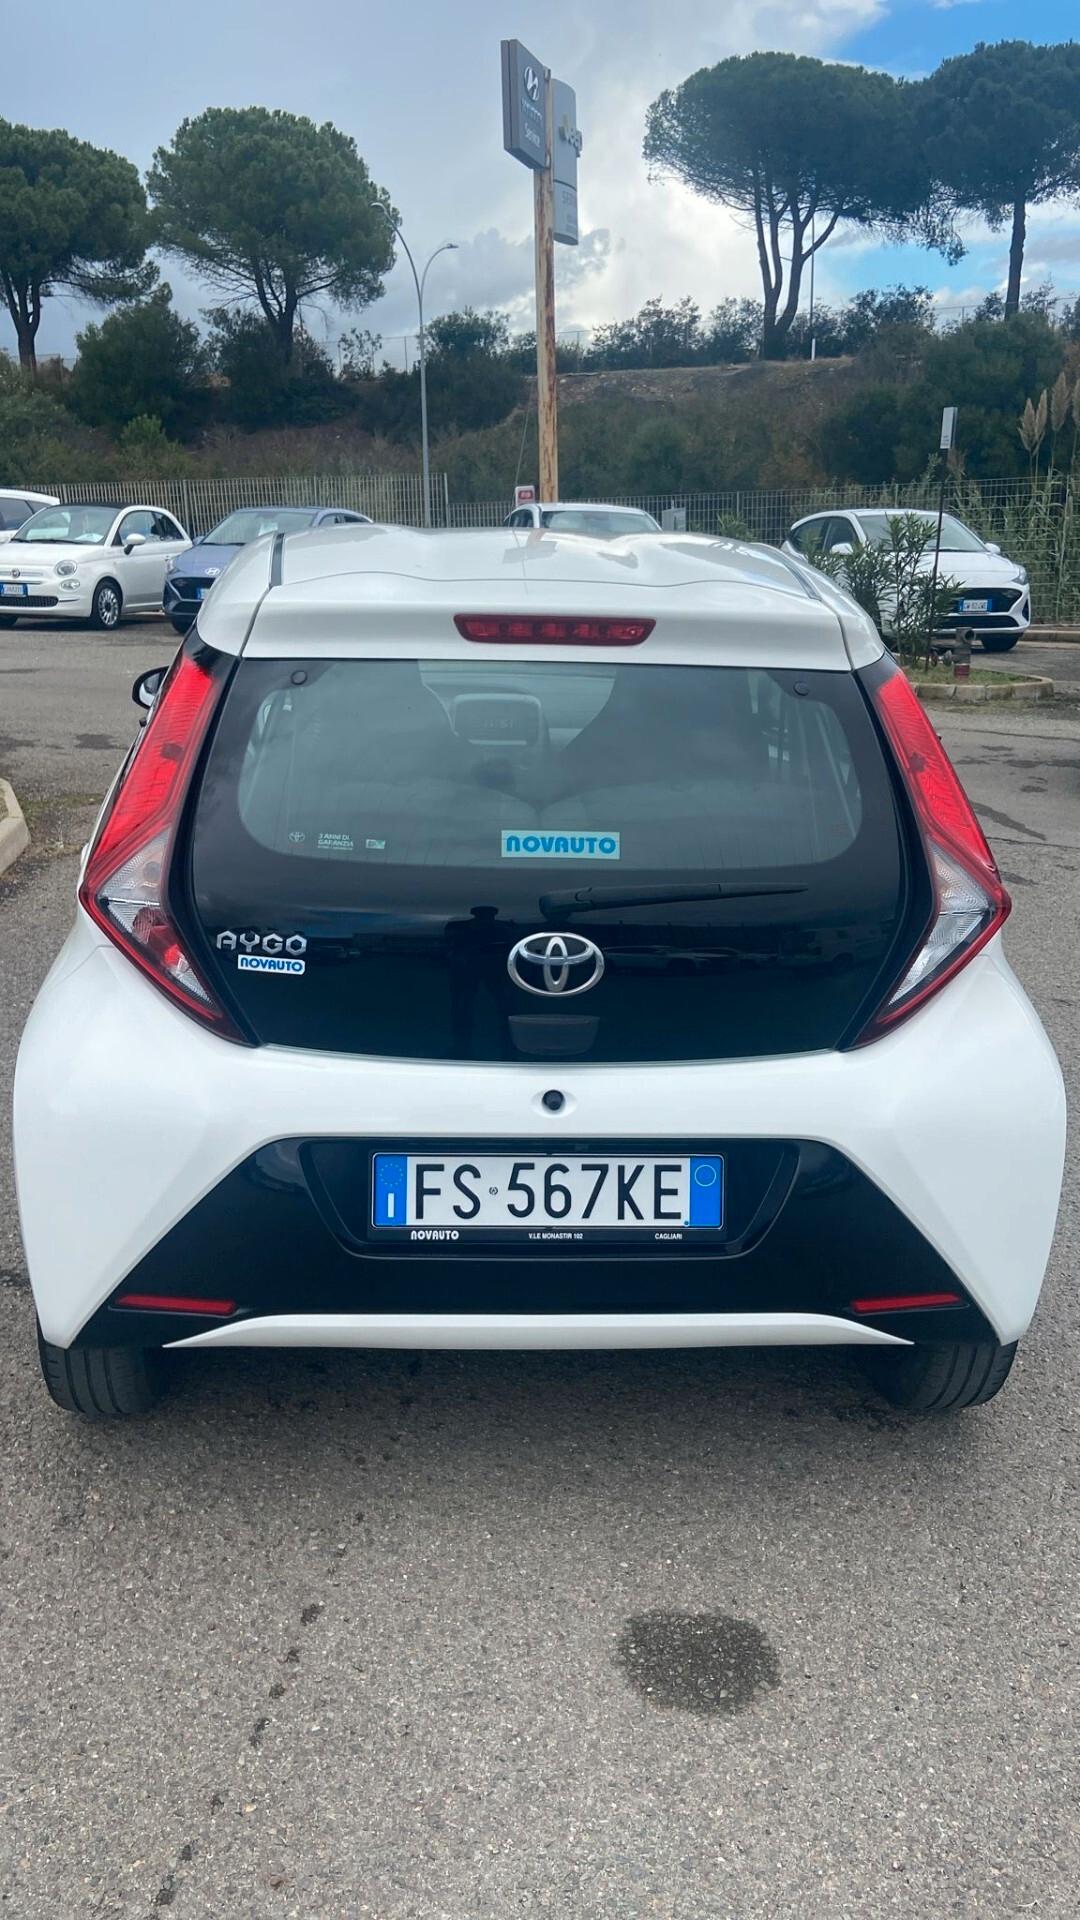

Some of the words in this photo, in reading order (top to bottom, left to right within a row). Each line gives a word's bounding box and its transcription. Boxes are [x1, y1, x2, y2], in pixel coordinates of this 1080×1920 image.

[318, 839, 354, 848] GARANZIA
[506, 835, 617, 854] NOVAUTO
[216, 930, 307, 956] AYGO
[240, 956, 303, 973] NOVAUTO
[387, 1193, 394, 1218] I
[415, 1163, 482, 1220] FS
[507, 1162, 682, 1220] 567KE
[410, 1230, 459, 1240] NOVAUTO
[528, 1232, 541, 1240] V.LE
[541, 1232, 572, 1240] MONASTIR
[573, 1232, 583, 1240] 102
